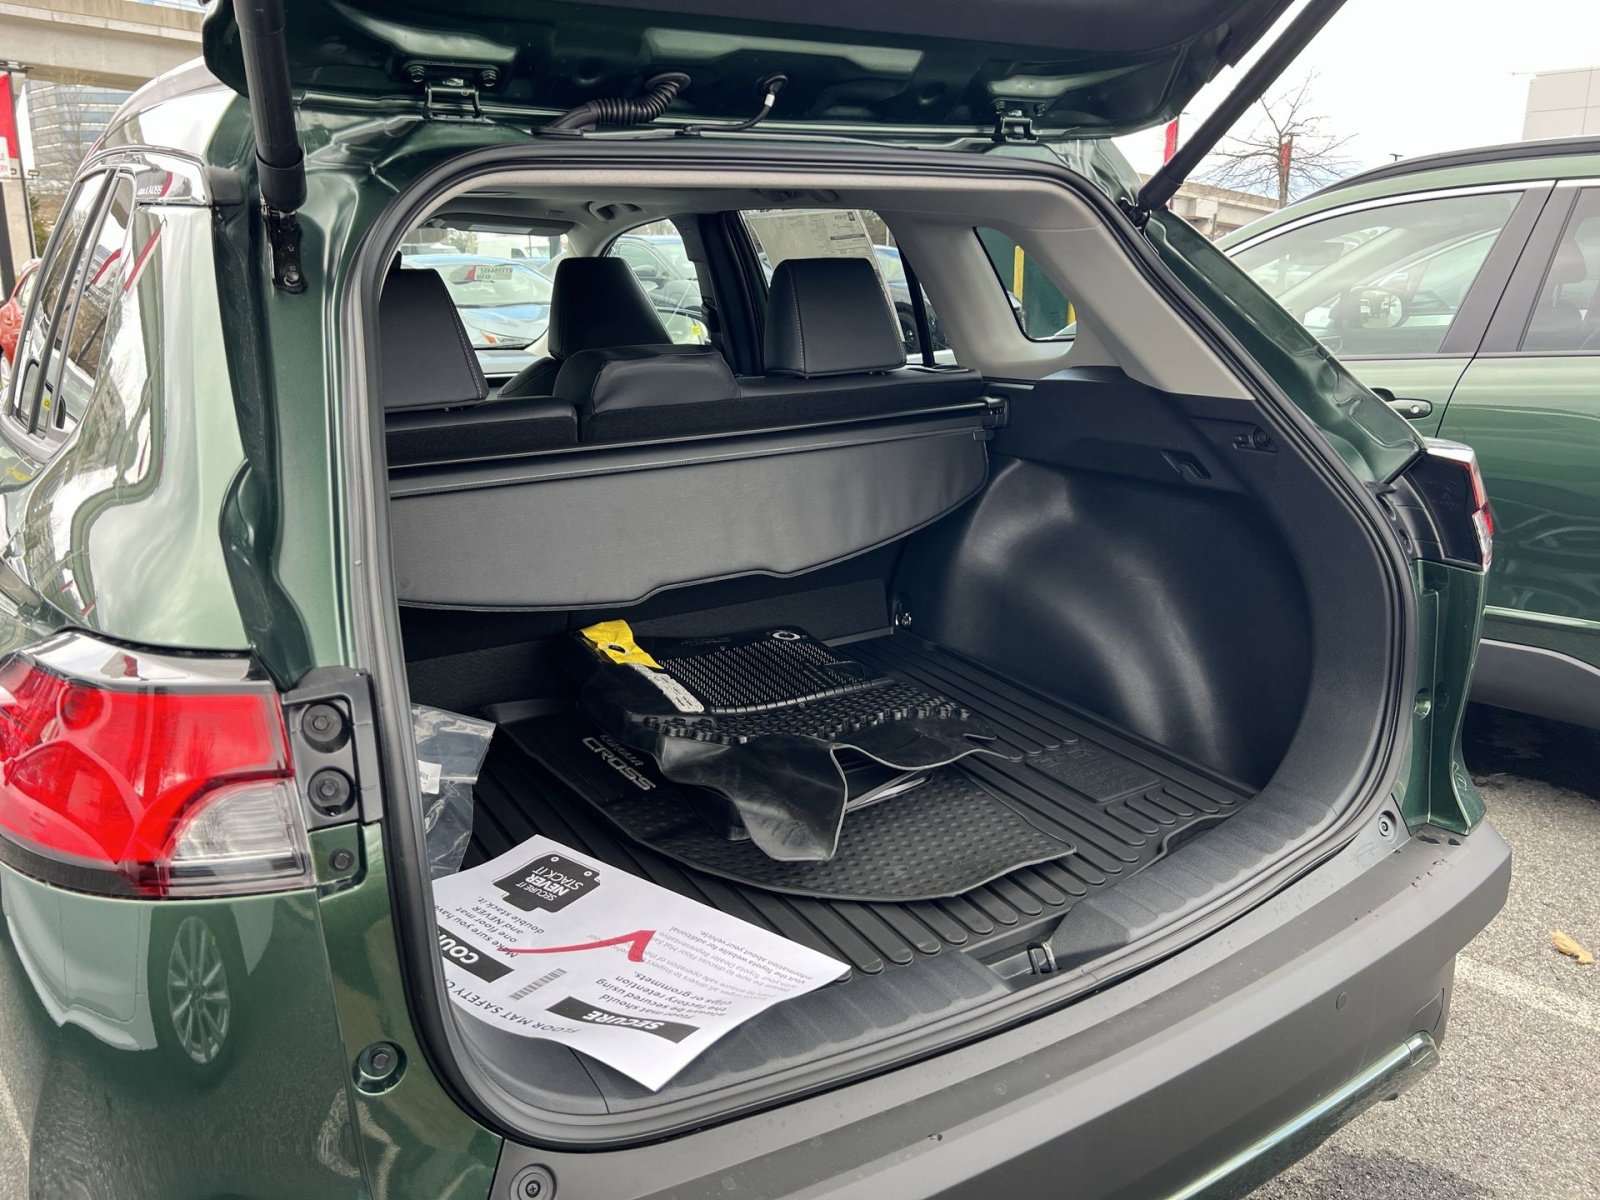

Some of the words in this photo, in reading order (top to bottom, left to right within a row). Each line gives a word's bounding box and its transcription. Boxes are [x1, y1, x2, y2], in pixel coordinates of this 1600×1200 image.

[581, 736, 658, 791] CROSS
[531, 864, 549, 876] IT
[514, 879, 527, 889] IT
[524, 872, 570, 897] NEVER
[542, 868, 584, 891] STACK
[522, 882, 558, 902] SECURE
[454, 905, 475, 919] mat
[470, 904, 506, 925] NEVER
[484, 901, 512, 917] stack
[452, 916, 474, 929] you
[472, 916, 499, 933] floor
[503, 921, 524, 934] and
[509, 913, 545, 933] double
[468, 925, 492, 941] sure
[498, 930, 517, 943] one
[668, 925, 707, 944] additional
[700, 930, 726, 943] vehicle.
[493, 938, 519, 959] Make
[663, 941, 678, 951] Mat
[706, 942, 718, 950] for
[724, 942, 744, 951] your
[655, 955, 666, 963] of
[678, 948, 697, 960] Floor
[710, 954, 735, 969] Dealer
[718, 946, 747, 962] website
[742, 948, 767, 962] about
[646, 959, 673, 975] inspect
[666, 959, 702, 977] operation
[698, 957, 725, 972] discuss
[735, 965, 759, 979] Toyota
[747, 960, 773, 974] Toyota
[767, 959, 813, 980] information
[672, 970, 682, 978] to
[725, 969, 734, 977] to
[773, 971, 788, 980] the
[788, 975, 805, 984] Visit
[595, 978, 625, 995] using
[614, 974, 665, 999] retention
[632, 971, 692, 998] grommets.
[681, 975, 708, 988] drivers
[452, 986, 503, 1014] SAFETY
[598, 992, 640, 1011] should
[622, 991, 669, 1009] secured
[663, 995, 706, 1010] factory
[639, 1006, 659, 1014] mat
[656, 1010, 693, 1019] Floor
[669, 1005, 685, 1013] be
[499, 1010, 533, 1027] MAT
[581, 1008, 665, 1030] SECURE
[531, 1021, 580, 1034] FLOOR
